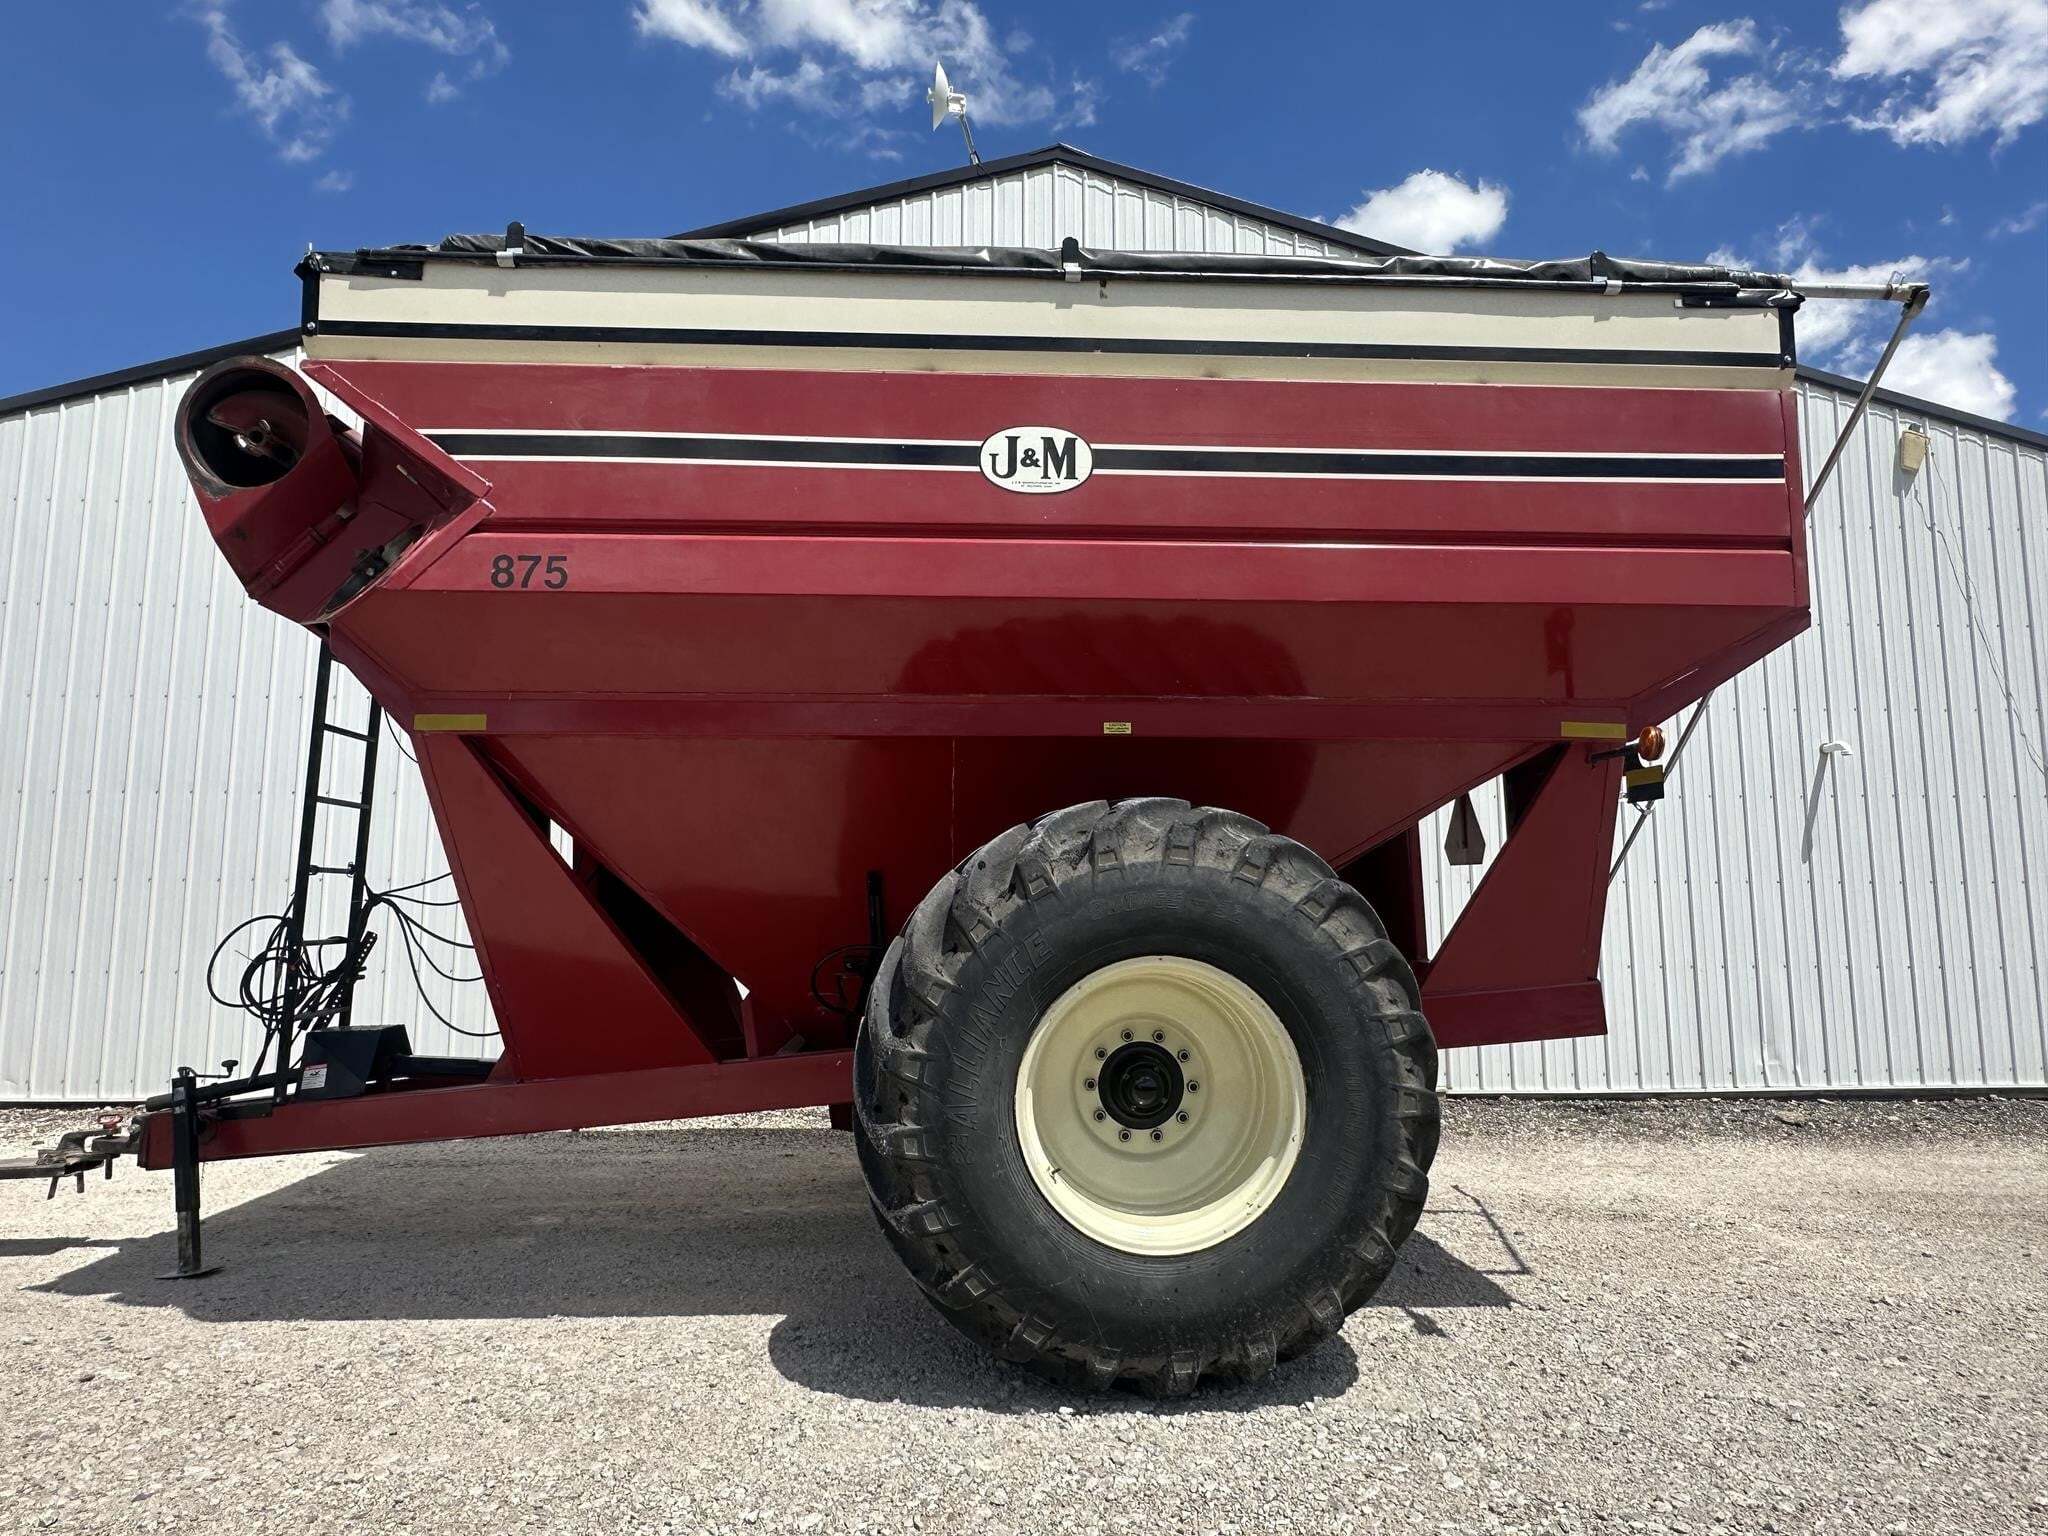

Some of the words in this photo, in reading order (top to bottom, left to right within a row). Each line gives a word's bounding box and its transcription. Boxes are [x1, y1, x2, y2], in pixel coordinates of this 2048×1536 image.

[989, 436, 1078, 480] J&M
[491, 554, 568, 589] 875
[946, 928, 1056, 1131] ALLIANCE
